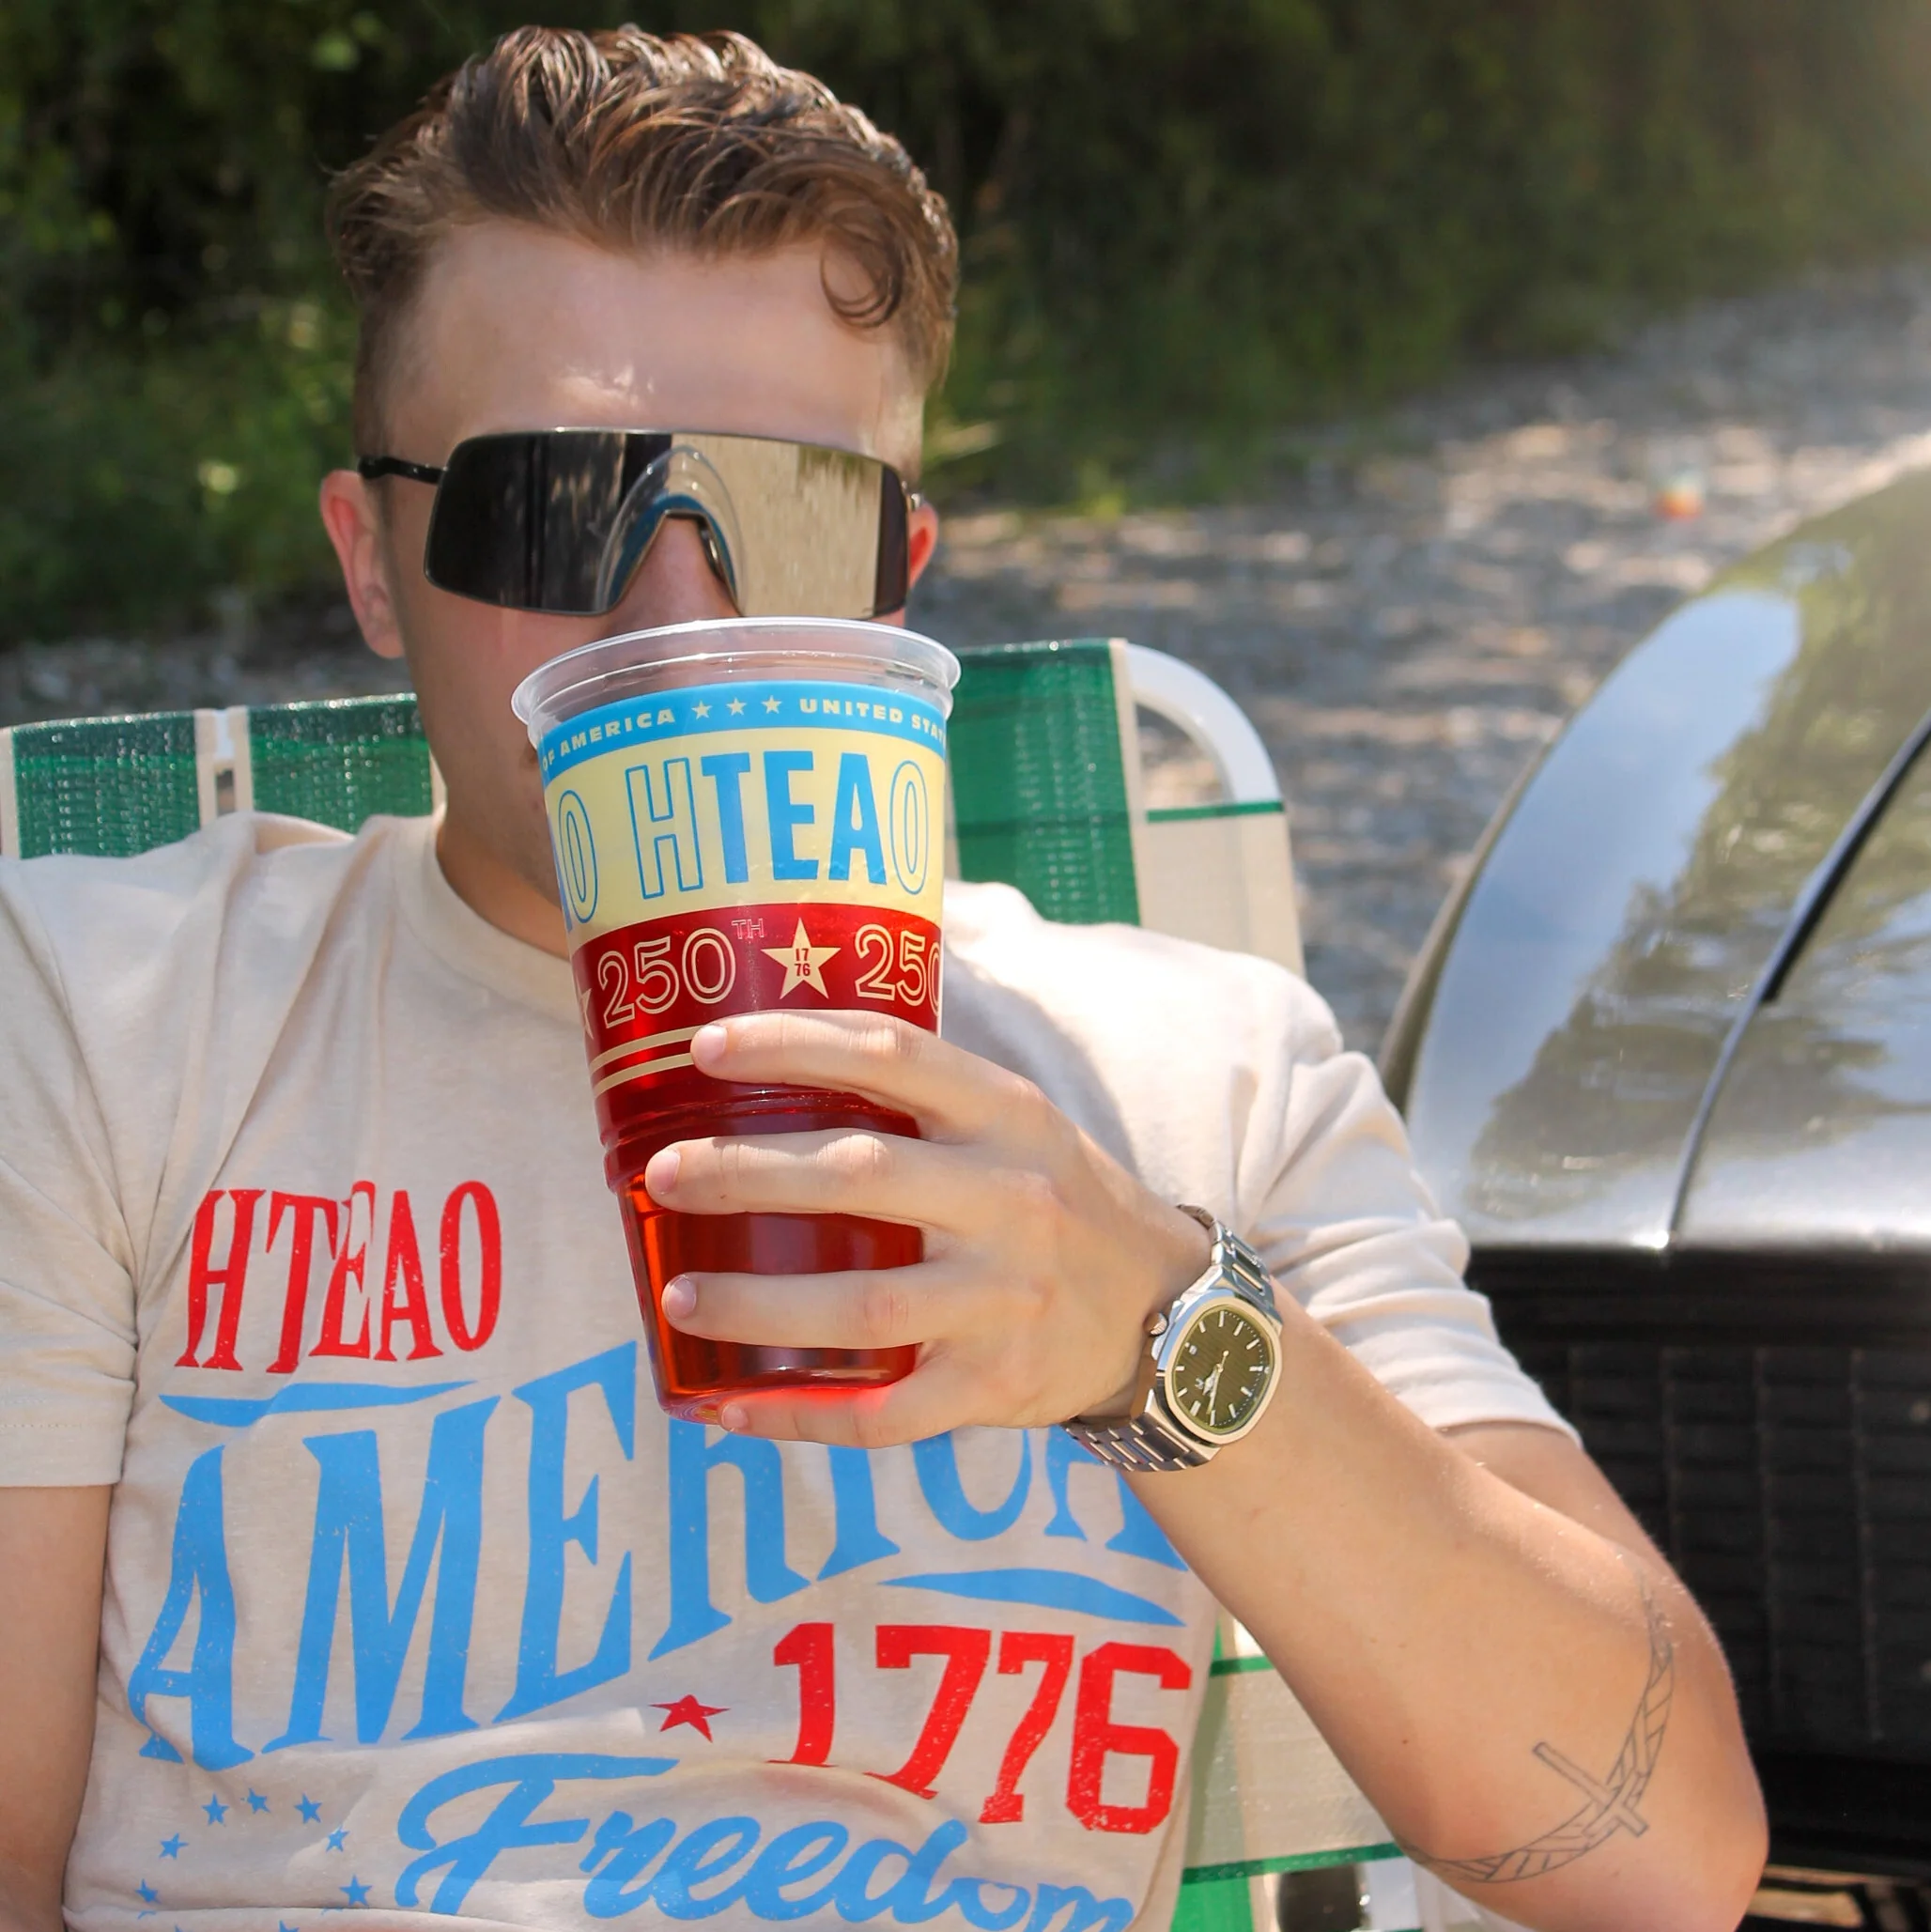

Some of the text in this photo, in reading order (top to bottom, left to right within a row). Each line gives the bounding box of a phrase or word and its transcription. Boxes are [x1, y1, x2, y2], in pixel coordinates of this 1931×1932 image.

[542, 749, 555, 771] OF
[560, 708, 675, 757] AMERICA
[799, 698, 903, 723] UNITED
[626, 750, 928, 900] HTEAO
[794, 963, 811, 977] 76
[174, 1180, 502, 1374] HTEAO
[765, 1622, 1192, 1835] 1776
